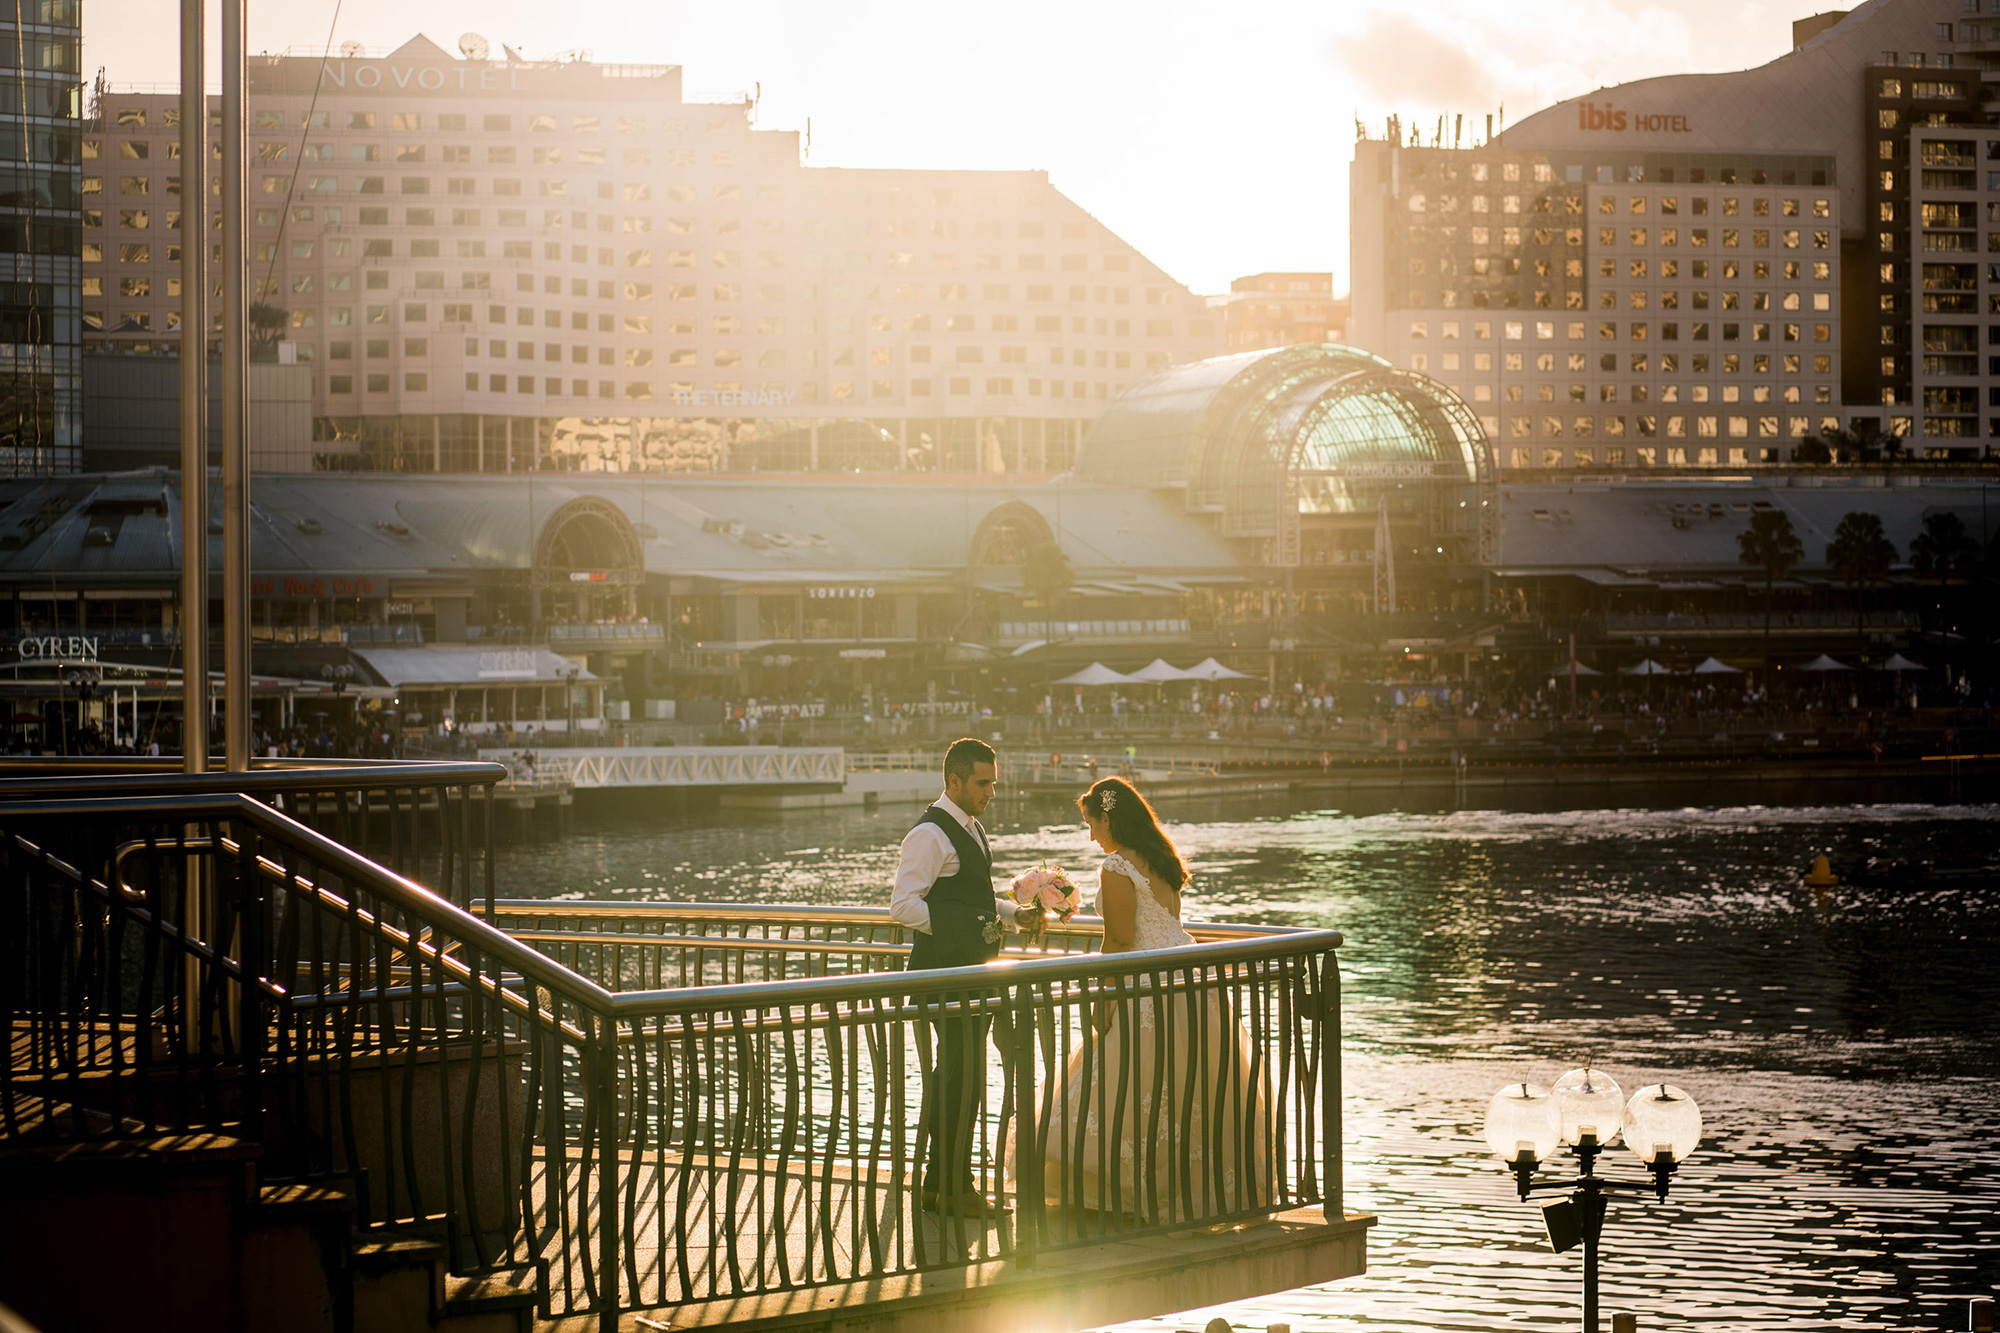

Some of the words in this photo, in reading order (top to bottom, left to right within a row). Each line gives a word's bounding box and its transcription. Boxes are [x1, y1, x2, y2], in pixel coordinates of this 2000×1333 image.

[319, 61, 529, 91] NOVOTEL
[1579, 102, 1627, 131] ibis
[1635, 114, 1693, 132] HOTEL
[673, 390, 707, 406] THE
[712, 390, 796, 406] TERNARY
[285, 577, 326, 597] Rock
[333, 577, 373, 597] Cafe
[18, 636, 99, 658] CYREN
[478, 650, 537, 671] CYREN
